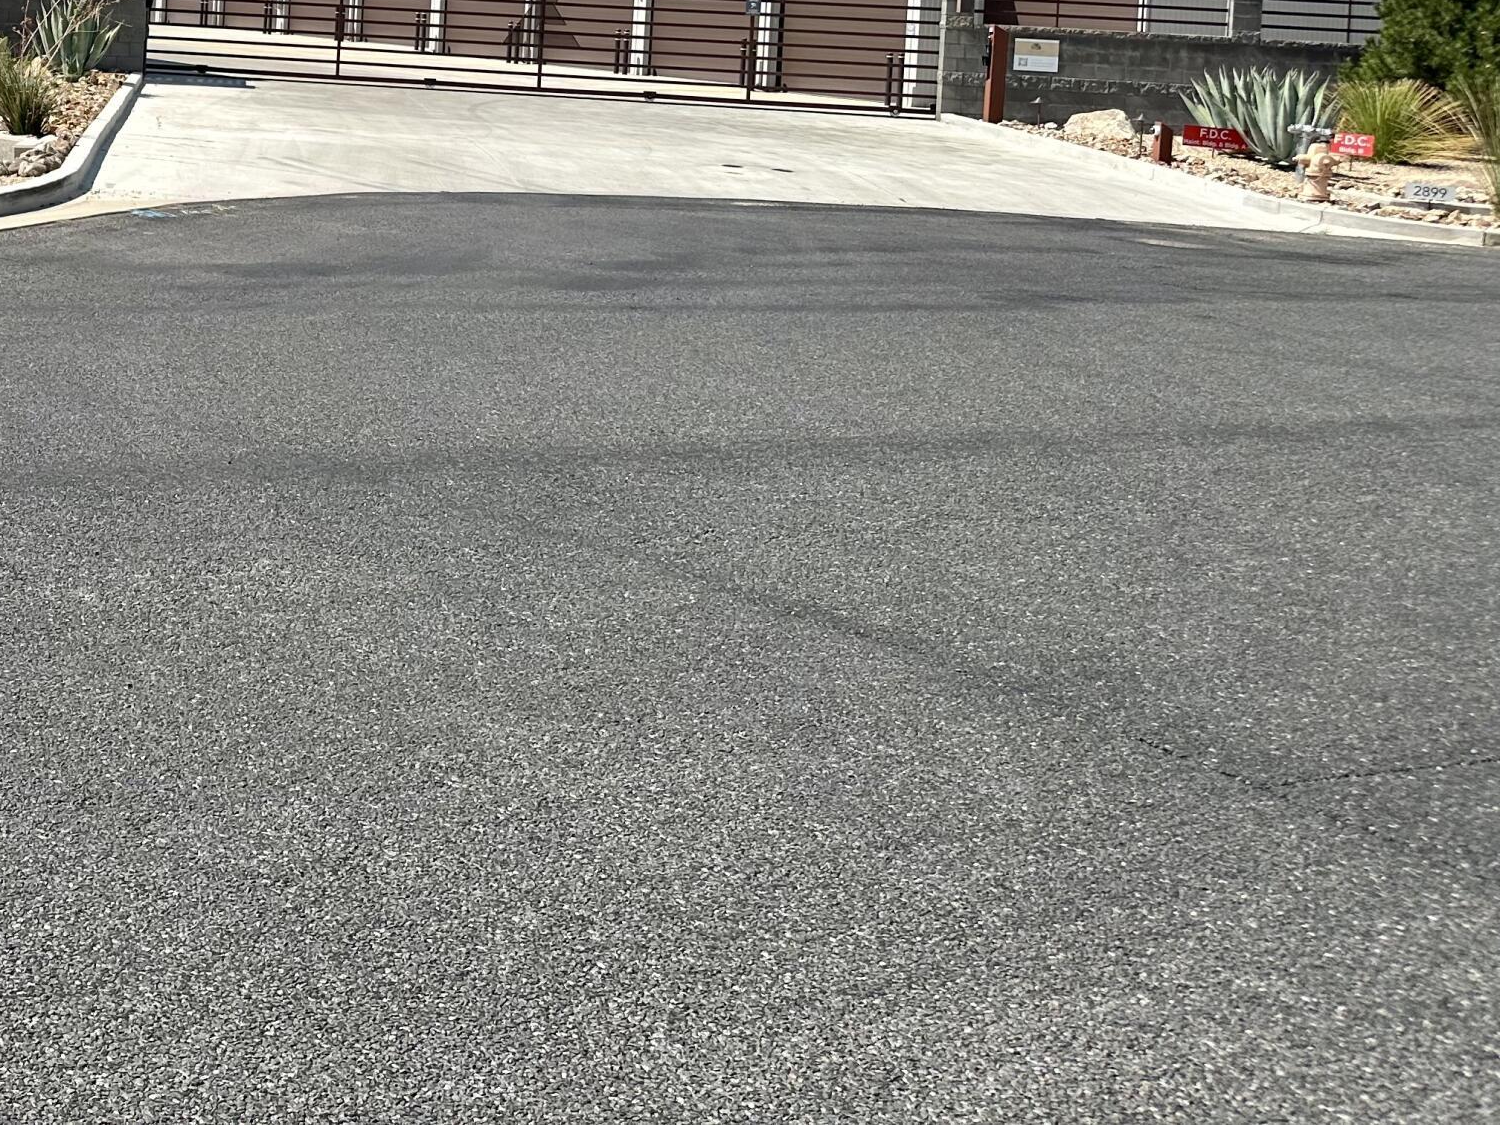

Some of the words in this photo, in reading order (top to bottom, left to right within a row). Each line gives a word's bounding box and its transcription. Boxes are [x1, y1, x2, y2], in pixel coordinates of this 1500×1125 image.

[1200, 128, 1232, 140] F.D.C.
[1333, 134, 1371, 147] F.D.C.
[1413, 185, 1447, 198] 2899
